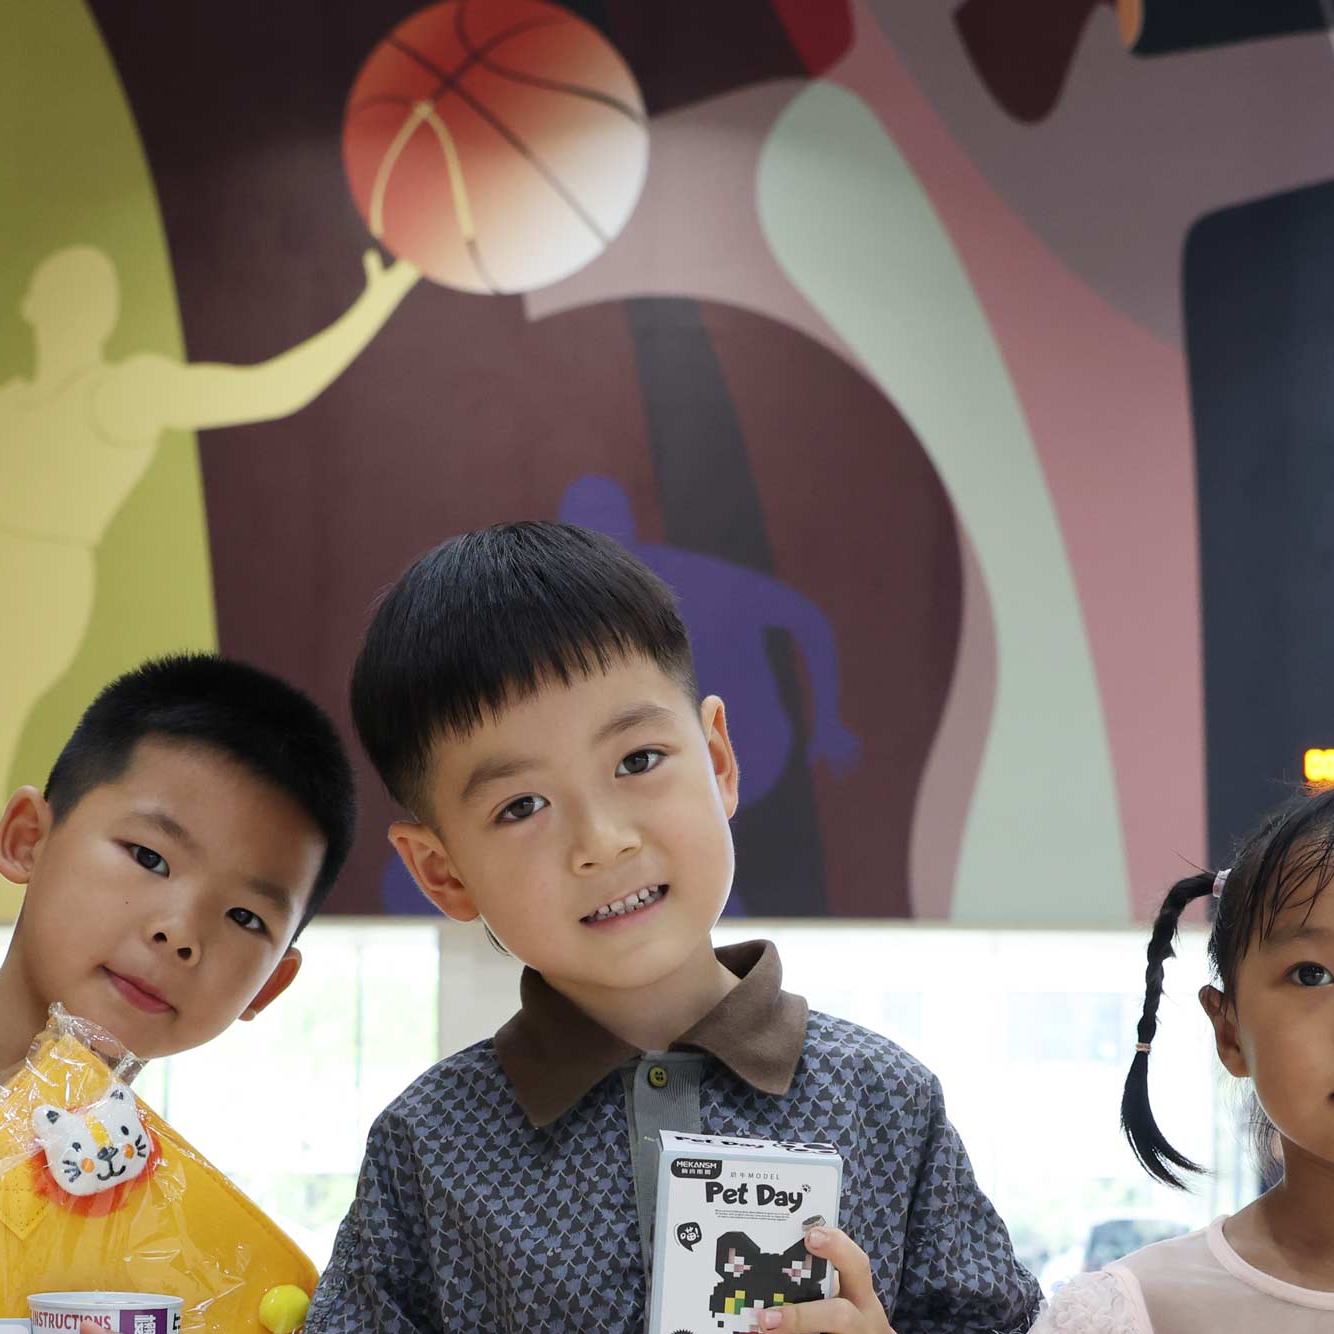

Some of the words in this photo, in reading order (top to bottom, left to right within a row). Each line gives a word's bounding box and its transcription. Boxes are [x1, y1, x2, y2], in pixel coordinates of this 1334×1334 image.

[676, 1160, 717, 1169] MEKANSM
[705, 1181, 749, 1205] Pet
[756, 1183, 803, 1213] Day
